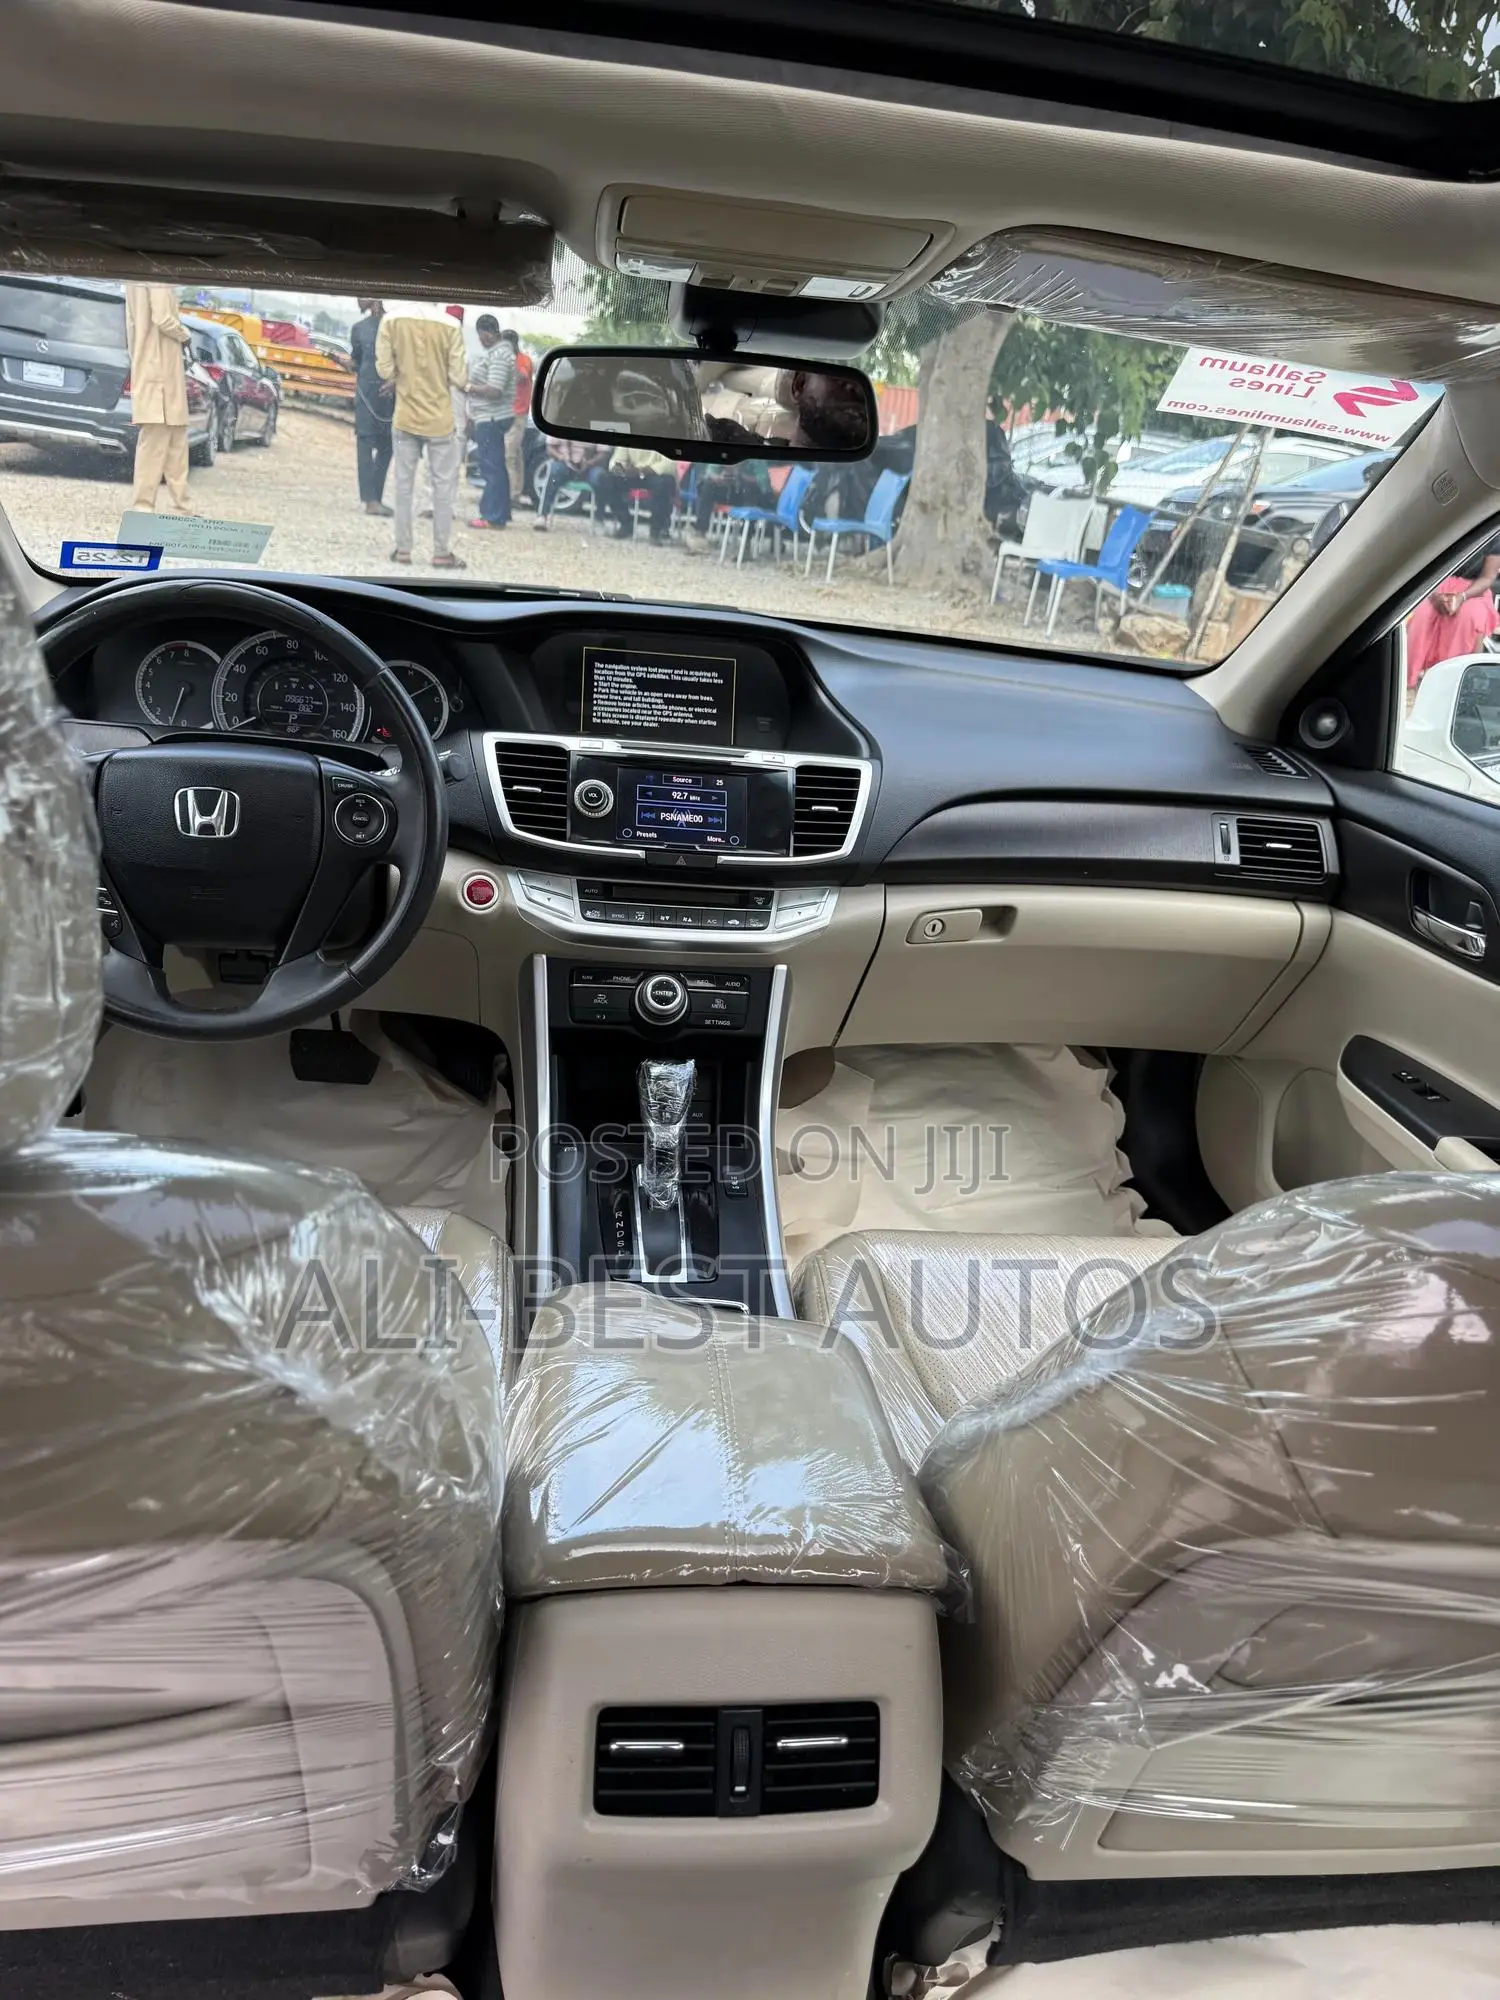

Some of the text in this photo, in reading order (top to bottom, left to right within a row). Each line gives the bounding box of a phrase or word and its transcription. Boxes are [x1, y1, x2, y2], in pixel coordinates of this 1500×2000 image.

[286, 639, 299, 650] 80
[169, 651, 175, 659] 7
[184, 649, 190, 657] 8
[255, 645, 269, 656] 60
[156, 657, 162, 665] 6
[232, 664, 247, 674] 40
[594, 668, 614, 676] location
[647, 672, 670, 680] satellites.
[689, 670, 711, 678] acquiring
[333, 673, 348, 683] 120
[225, 692, 238, 702] 20
[155, 707, 161, 715] 2
[340, 703, 356, 712] 140
[632, 702, 651, 710] articles,
[694, 706, 717, 714] electrical
[231, 716, 239, 726] 0
[634, 714, 658, 722] displayed
[658, 716, 684, 724] repeatedly
[331, 729, 347, 739] 160
[672, 775, 693, 785] Source
[671, 790, 688, 801] 92.7
[660, 813, 703, 823] PSNAME00
[636, 830, 658, 839] Presets
